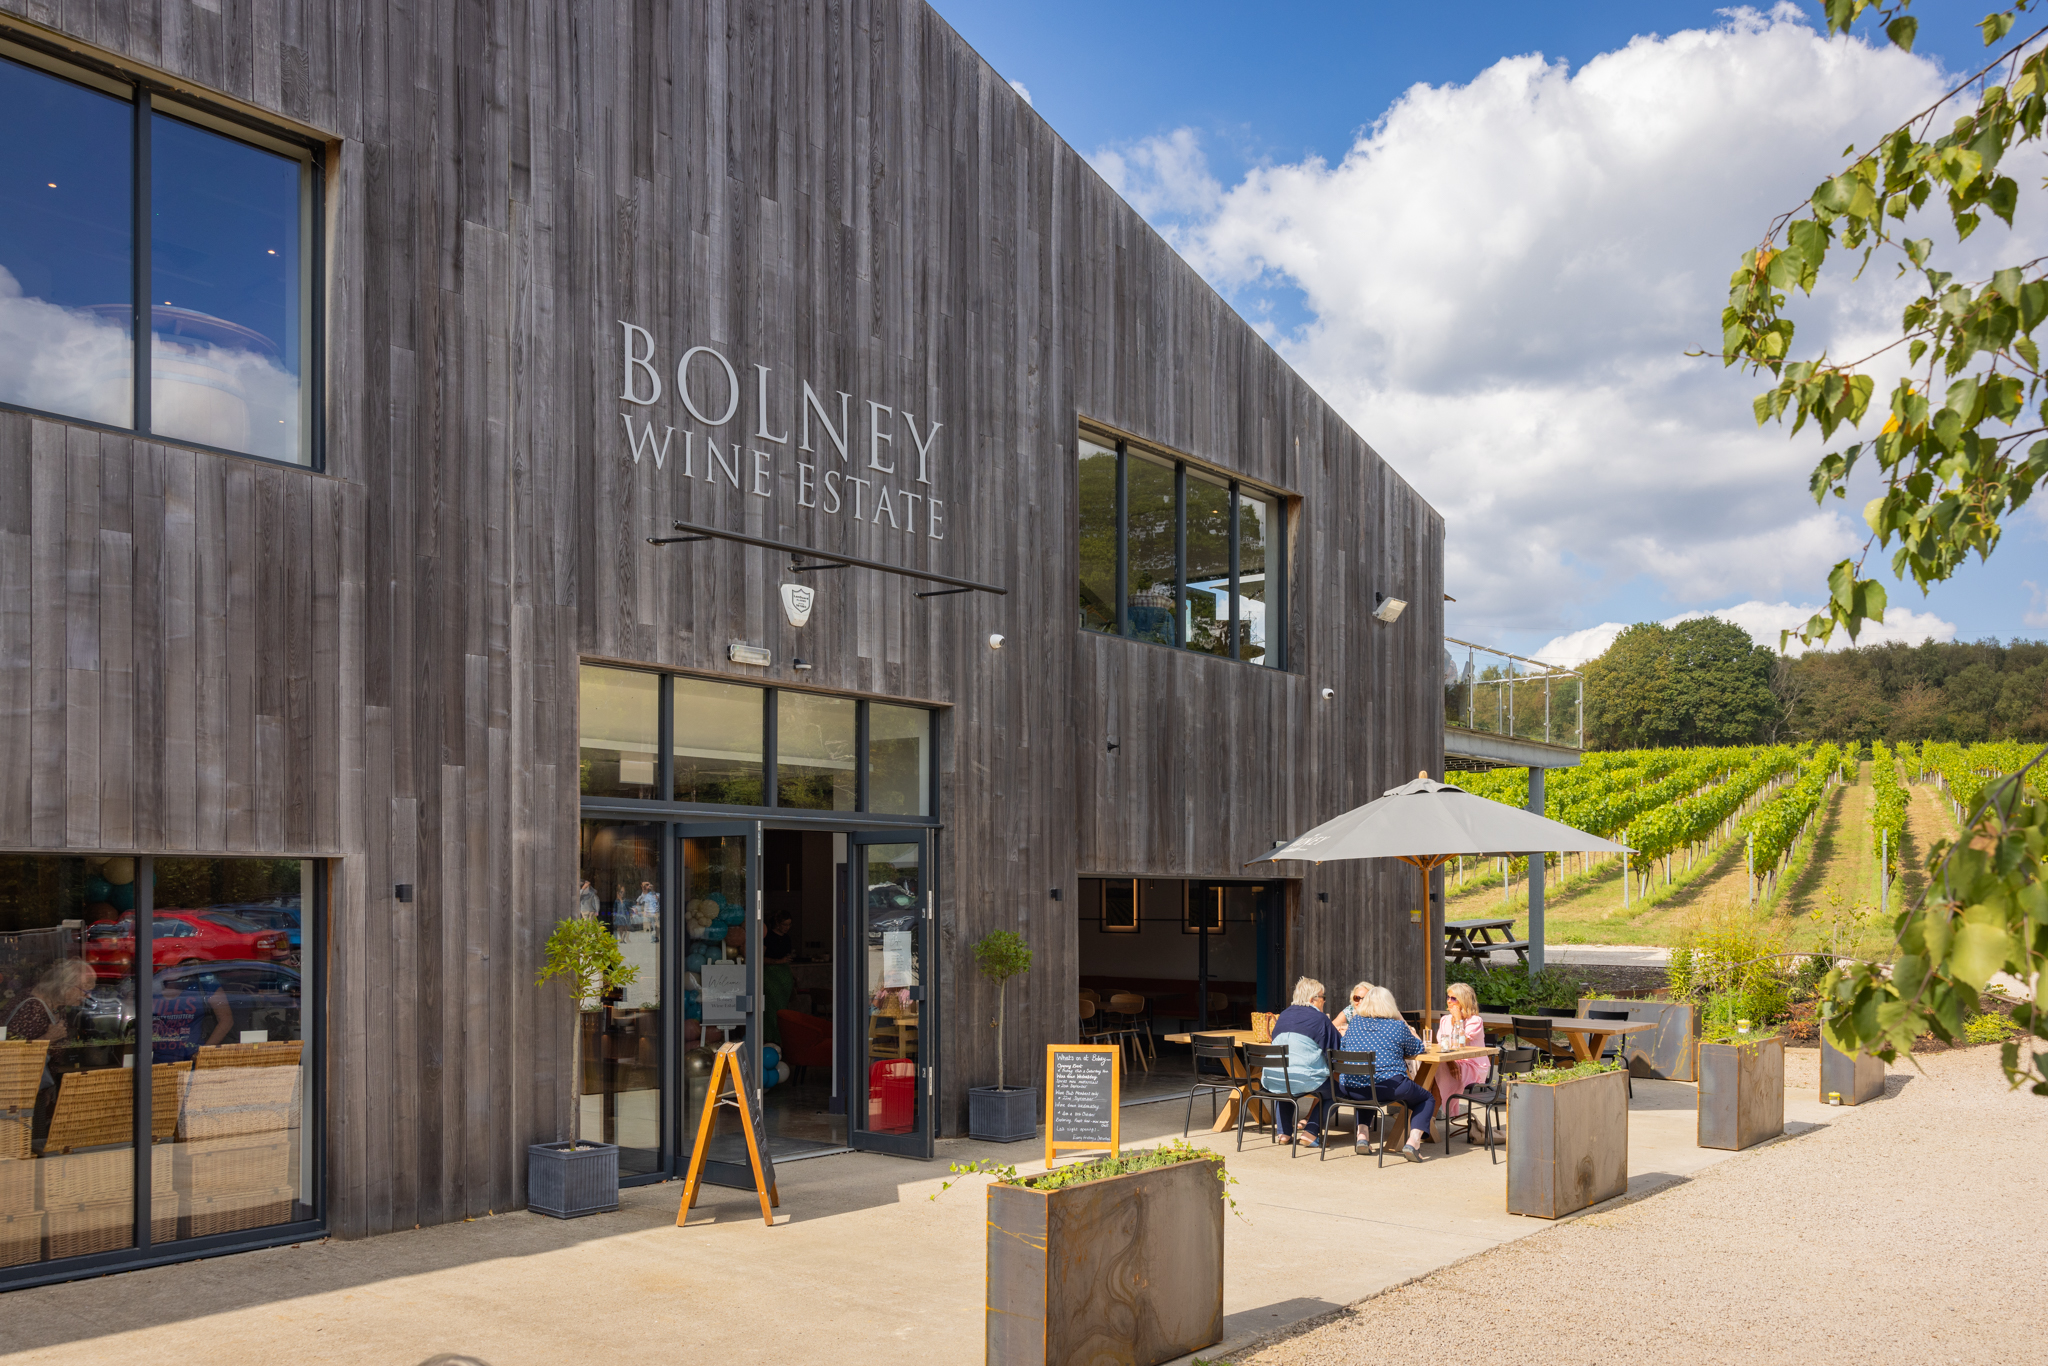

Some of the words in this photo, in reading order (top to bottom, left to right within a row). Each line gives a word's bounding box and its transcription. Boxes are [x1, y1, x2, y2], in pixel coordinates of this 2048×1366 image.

[617, 319, 944, 485] BOLNEY
[619, 412, 772, 497] WINE
[796, 460, 944, 540] ESTATE
[708, 974, 741, 988] Welcome
